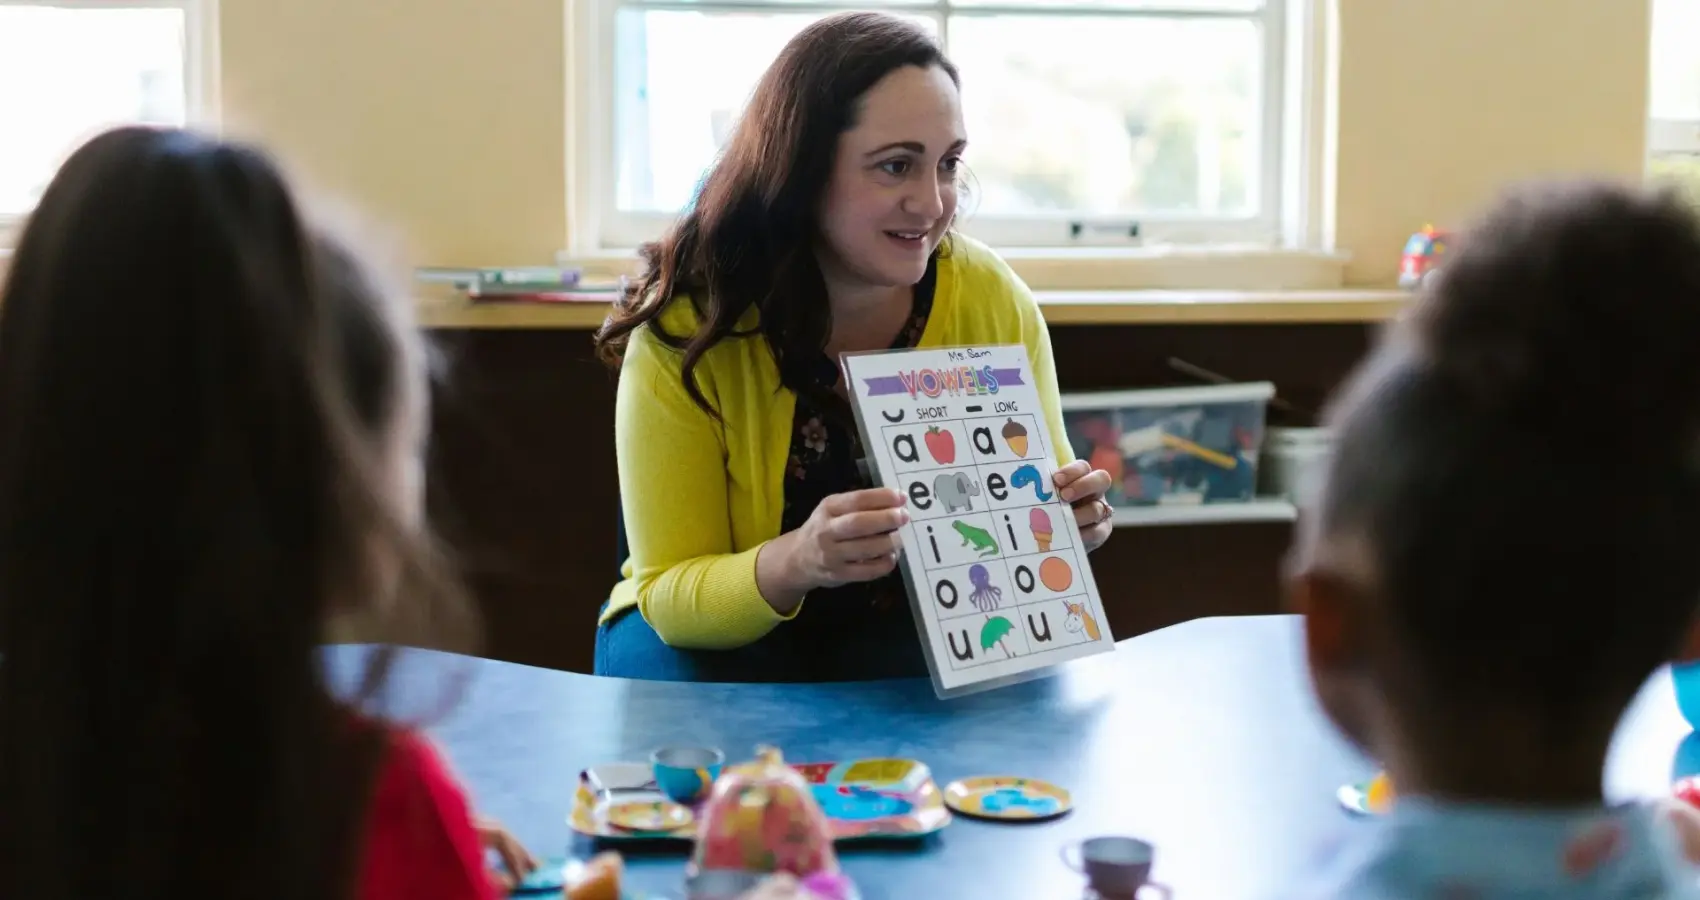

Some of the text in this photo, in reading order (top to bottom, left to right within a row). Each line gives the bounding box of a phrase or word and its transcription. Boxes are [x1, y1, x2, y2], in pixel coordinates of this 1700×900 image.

[948, 349, 992, 362] Ms. Sam
[898, 365, 1000, 399] VOWELS
[916, 406, 949, 420] SHORT
[994, 401, 1018, 413] LONG
[893, 434, 920, 463] a
[972, 427, 997, 455] a
[908, 481, 932, 510] e
[986, 472, 1008, 501] e
[926, 525, 941, 563] i
[1003, 514, 1018, 551] i
[1015, 565, 1035, 593] o
[936, 579, 958, 609] o
[1028, 611, 1052, 642] u
[948, 629, 974, 661] u
